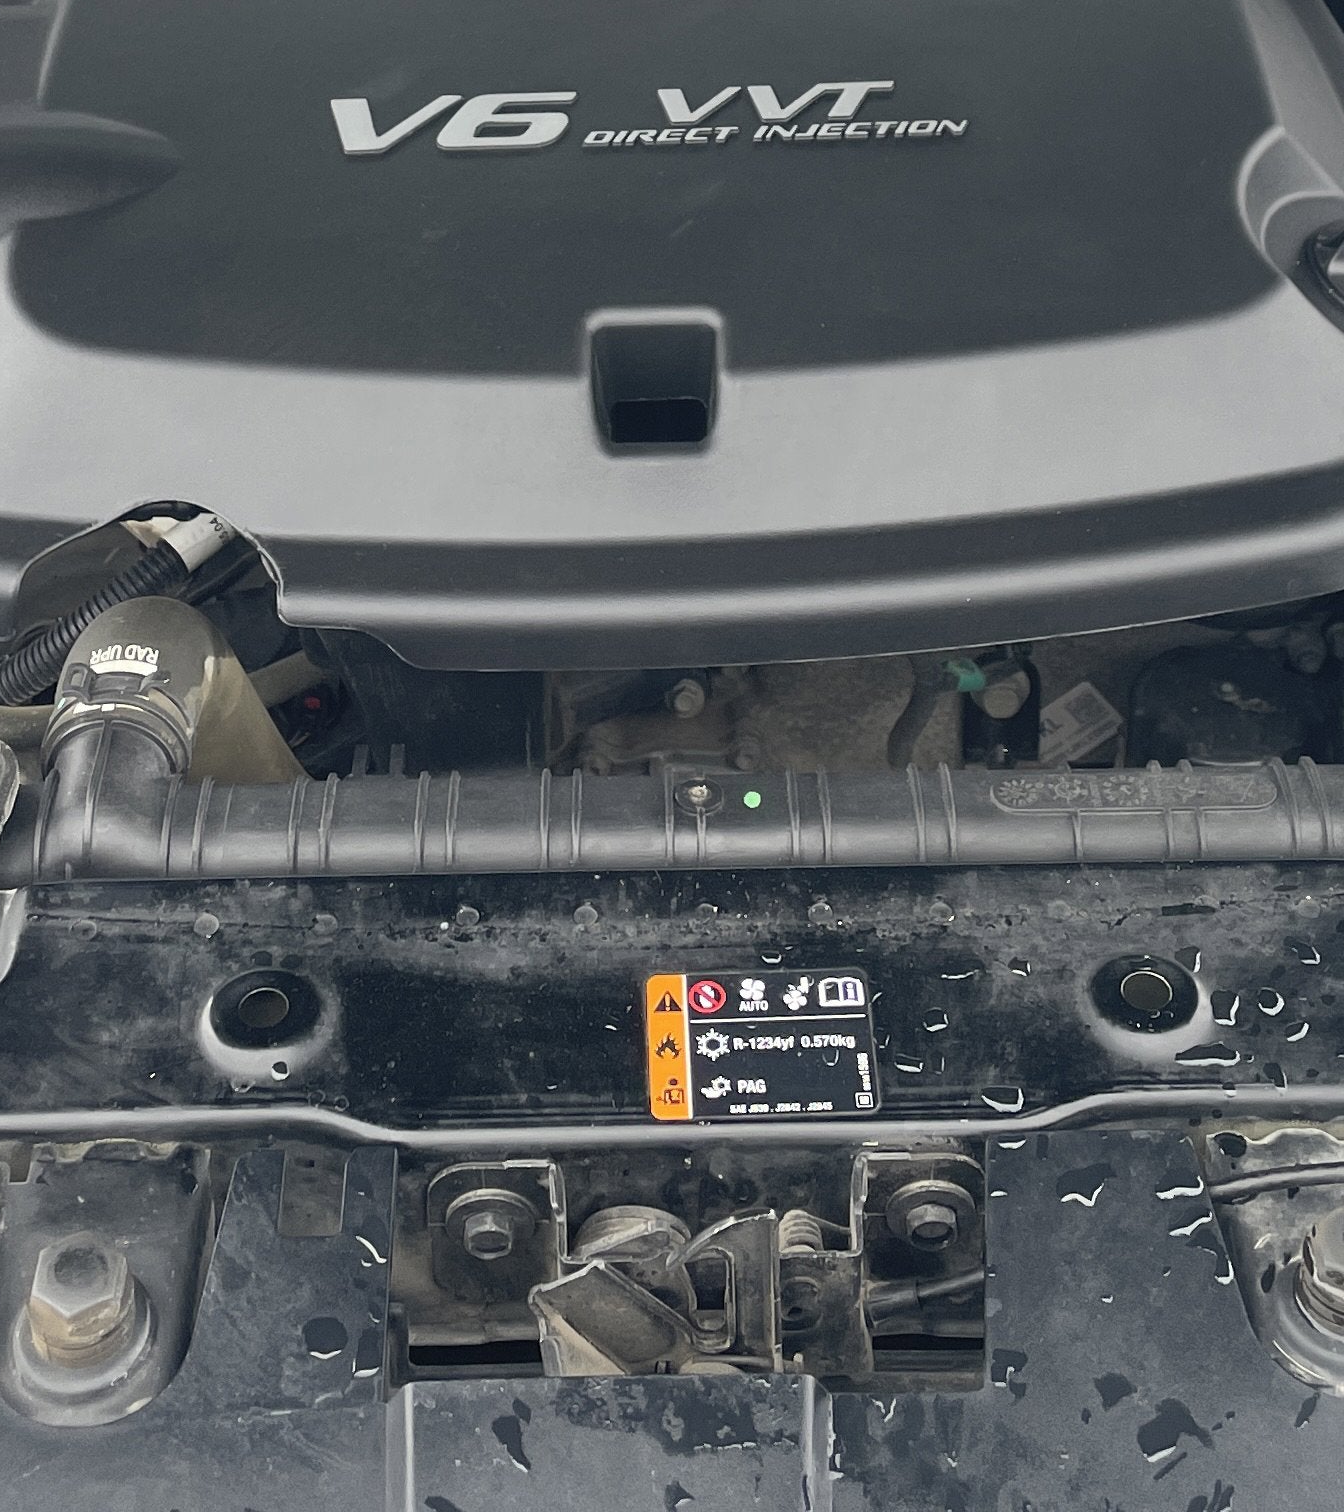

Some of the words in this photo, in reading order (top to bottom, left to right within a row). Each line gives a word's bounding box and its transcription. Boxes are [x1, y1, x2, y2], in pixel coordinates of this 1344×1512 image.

[330, 90, 577, 155] V6
[657, 80, 895, 126] VVT
[582, 126, 740, 148] DIRECT
[753, 119, 969, 144] INJECTION
[89, 644, 123, 665] UPR
[124, 644, 160, 665] RAD
[739, 1000, 769, 1012] AUTO
[732, 1035, 796, 1052] R-1234yf
[800, 1034, 856, 1049] 0.570kg
[737, 1078, 767, 1094] PAG
